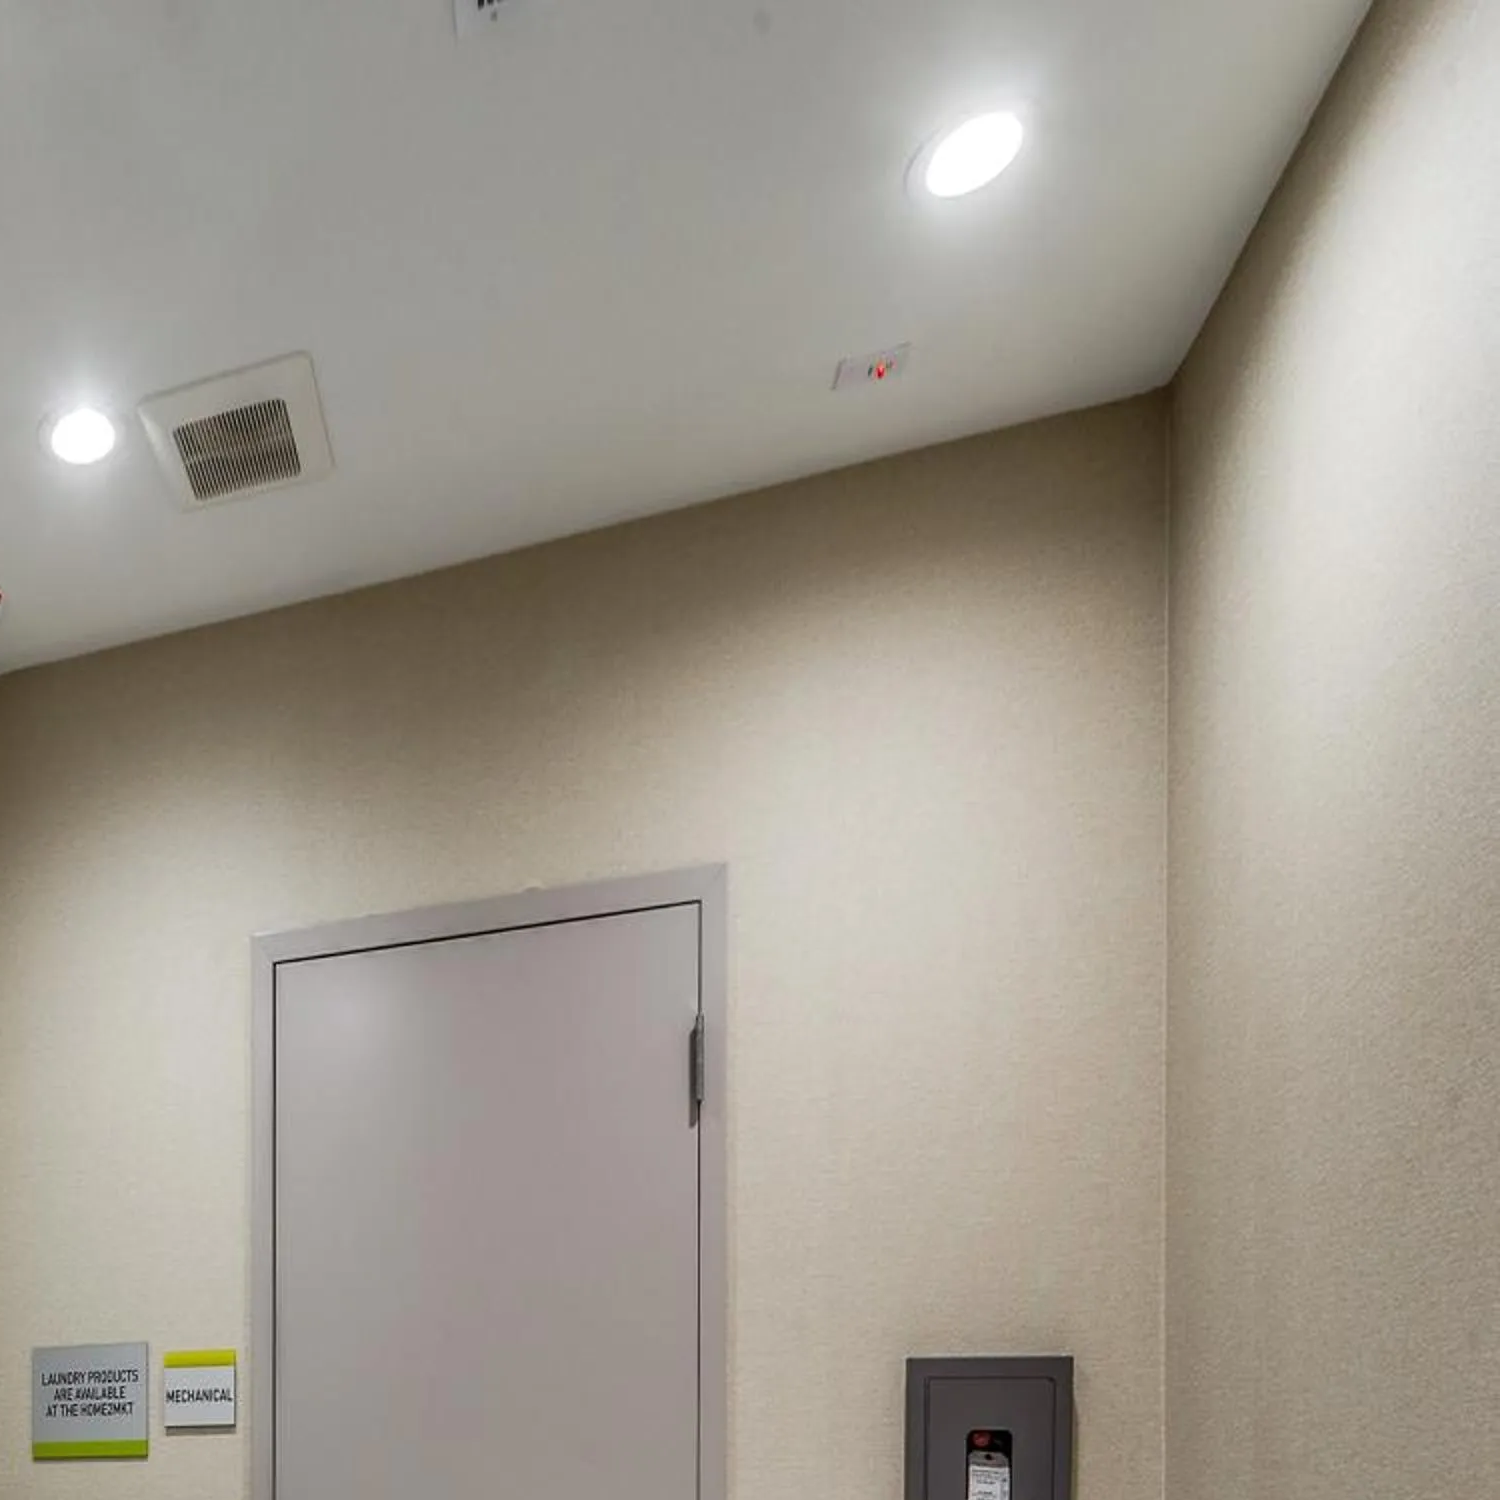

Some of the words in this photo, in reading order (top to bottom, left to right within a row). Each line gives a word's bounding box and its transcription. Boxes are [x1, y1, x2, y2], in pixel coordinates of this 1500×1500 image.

[41, 1371, 86, 1387] LAUNDRY
[88, 1369, 139, 1385] PRODUCTS
[53, 1387, 74, 1401] ARE
[75, 1386, 126, 1400] AVAILABLE
[166, 1387, 233, 1404] MECHANICAL
[46, 1404, 58, 1418] AT
[60, 1403, 79, 1417] THE
